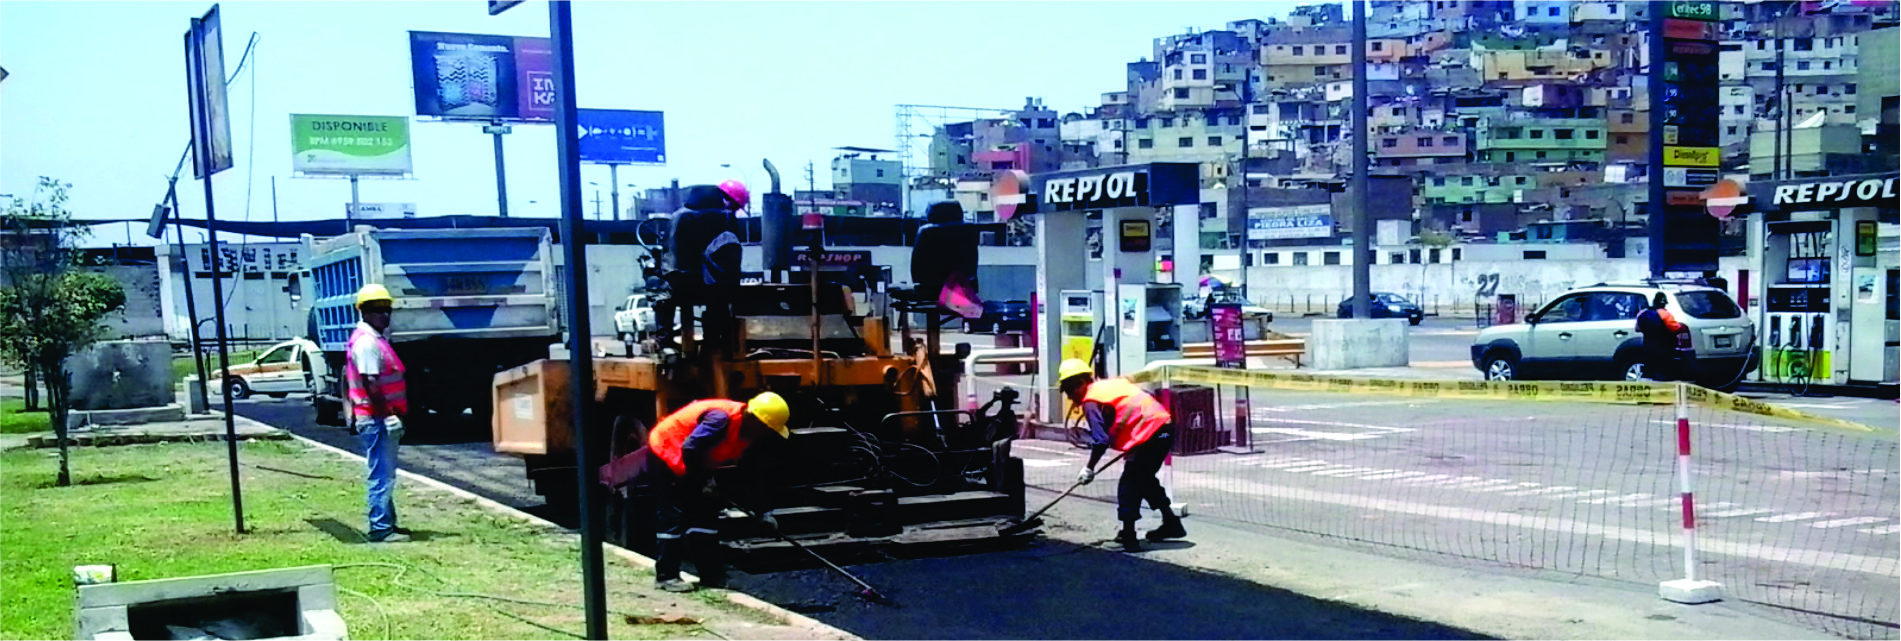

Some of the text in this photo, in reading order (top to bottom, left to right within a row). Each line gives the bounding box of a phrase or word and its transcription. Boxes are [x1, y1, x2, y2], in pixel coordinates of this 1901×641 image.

[312, 121, 388, 132] DISPONIBLE
[1044, 171, 1137, 204] REPSOL
[1773, 178, 1897, 205] REPSOL
[1254, 219, 1324, 229] PIEDRA LIZA
[1476, 273, 1500, 297] 27
